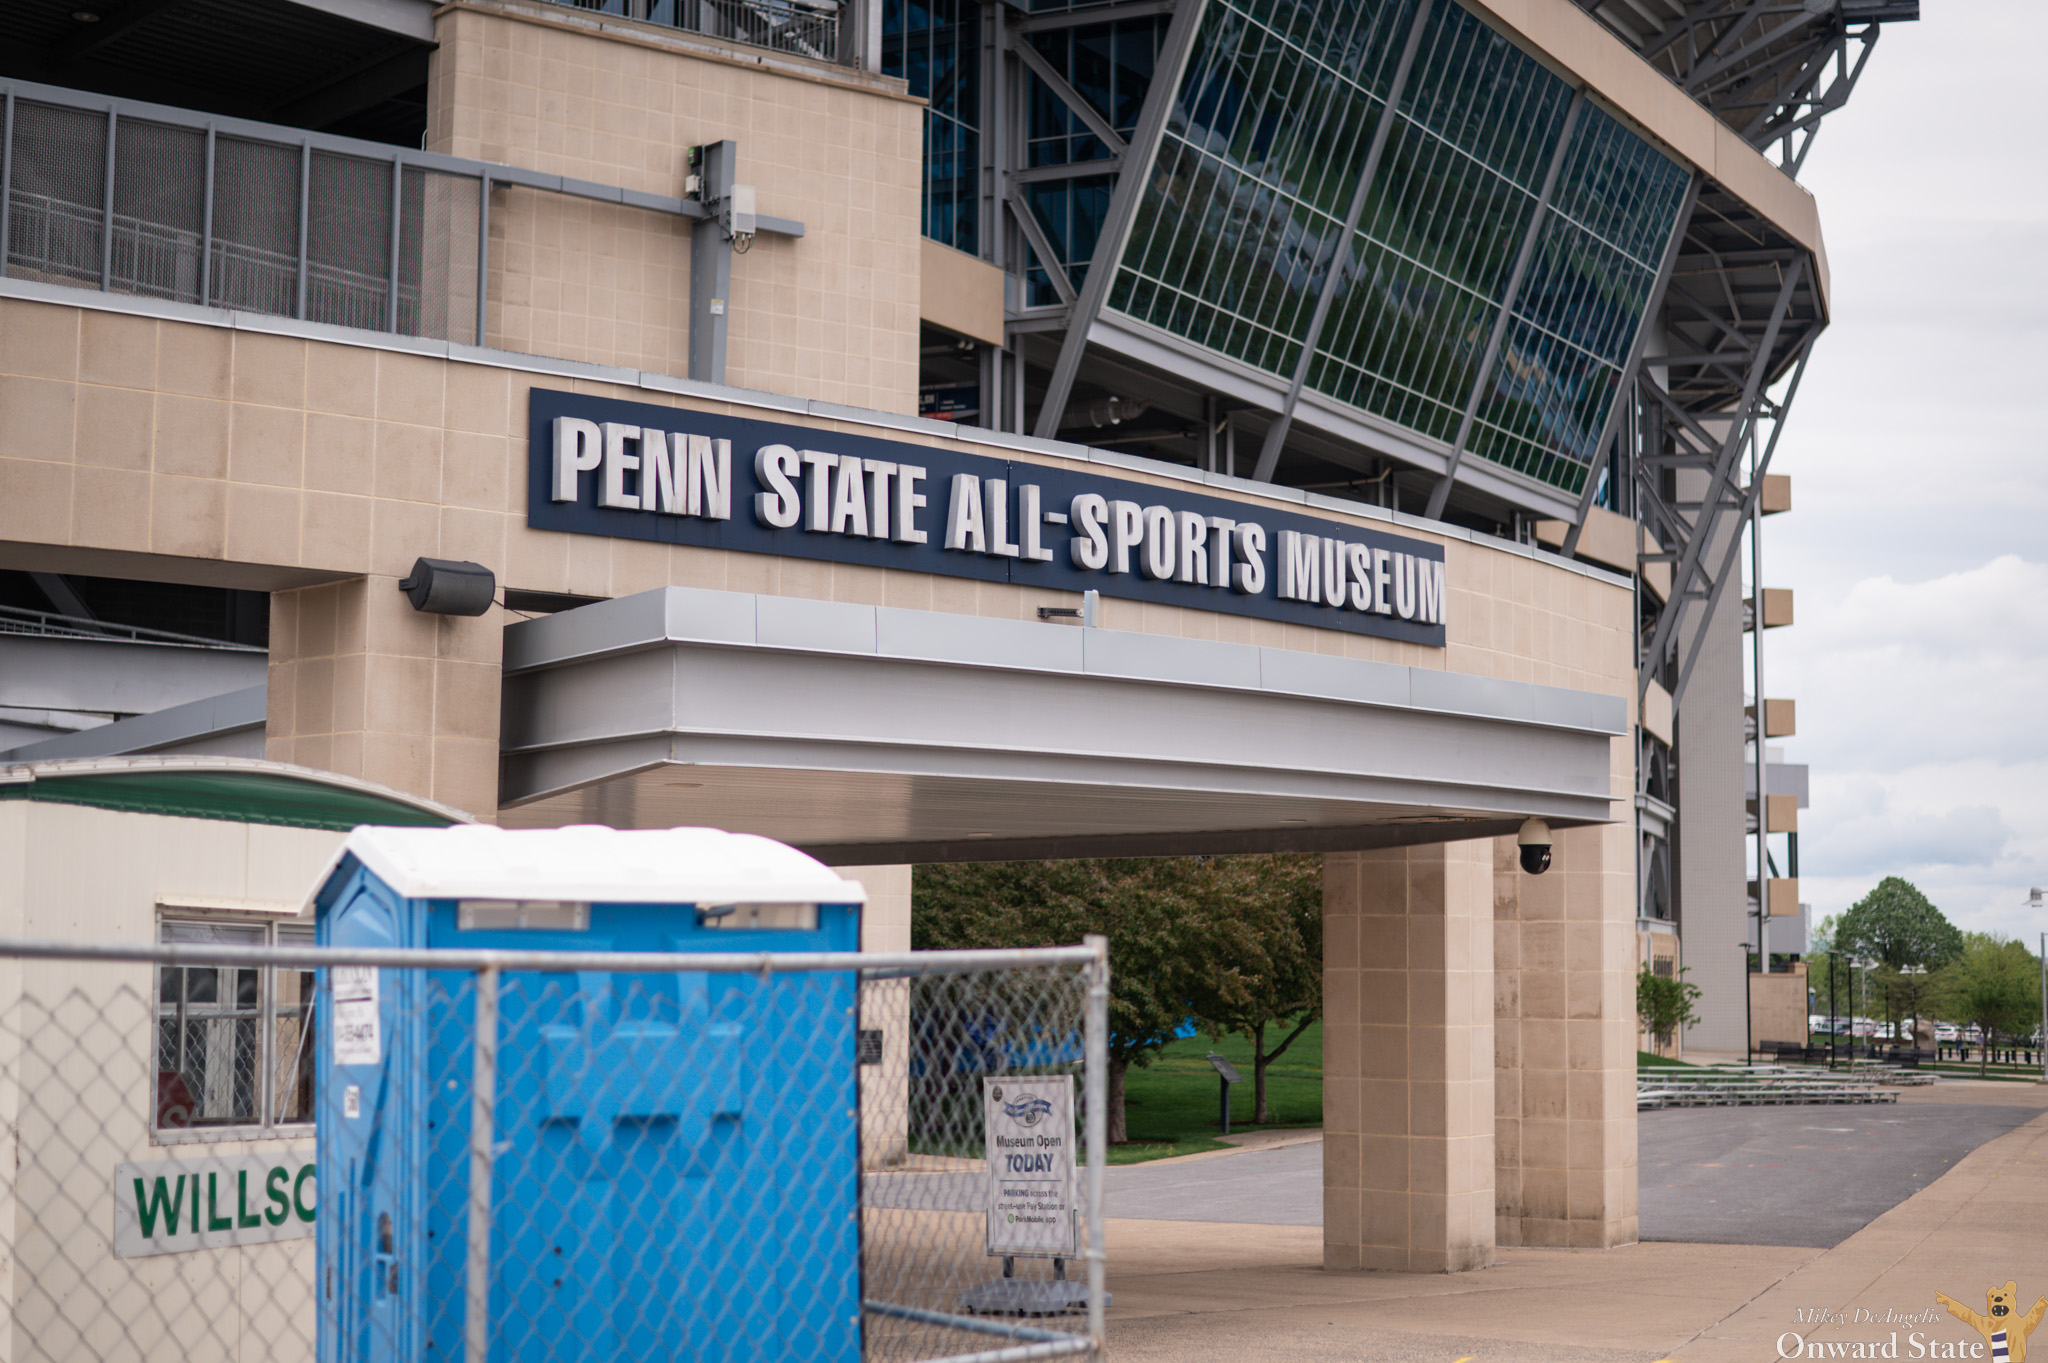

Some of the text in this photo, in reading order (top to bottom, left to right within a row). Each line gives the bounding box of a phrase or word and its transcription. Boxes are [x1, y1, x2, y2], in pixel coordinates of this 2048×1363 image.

[551, 415, 1446, 625] PENN STATE ALL-SPORTS MUSEUM
[996, 1134, 1062, 1150] Museum Open
[1005, 1153, 1054, 1173] TODAY
[1003, 1189, 1059, 1198] PARKING across the
[1026, 1202, 1037, 1212] Pay
[1037, 1202, 1058, 1211] Station
[1058, 1203, 1065, 1211] or
[1045, 1216, 1057, 1225] app
